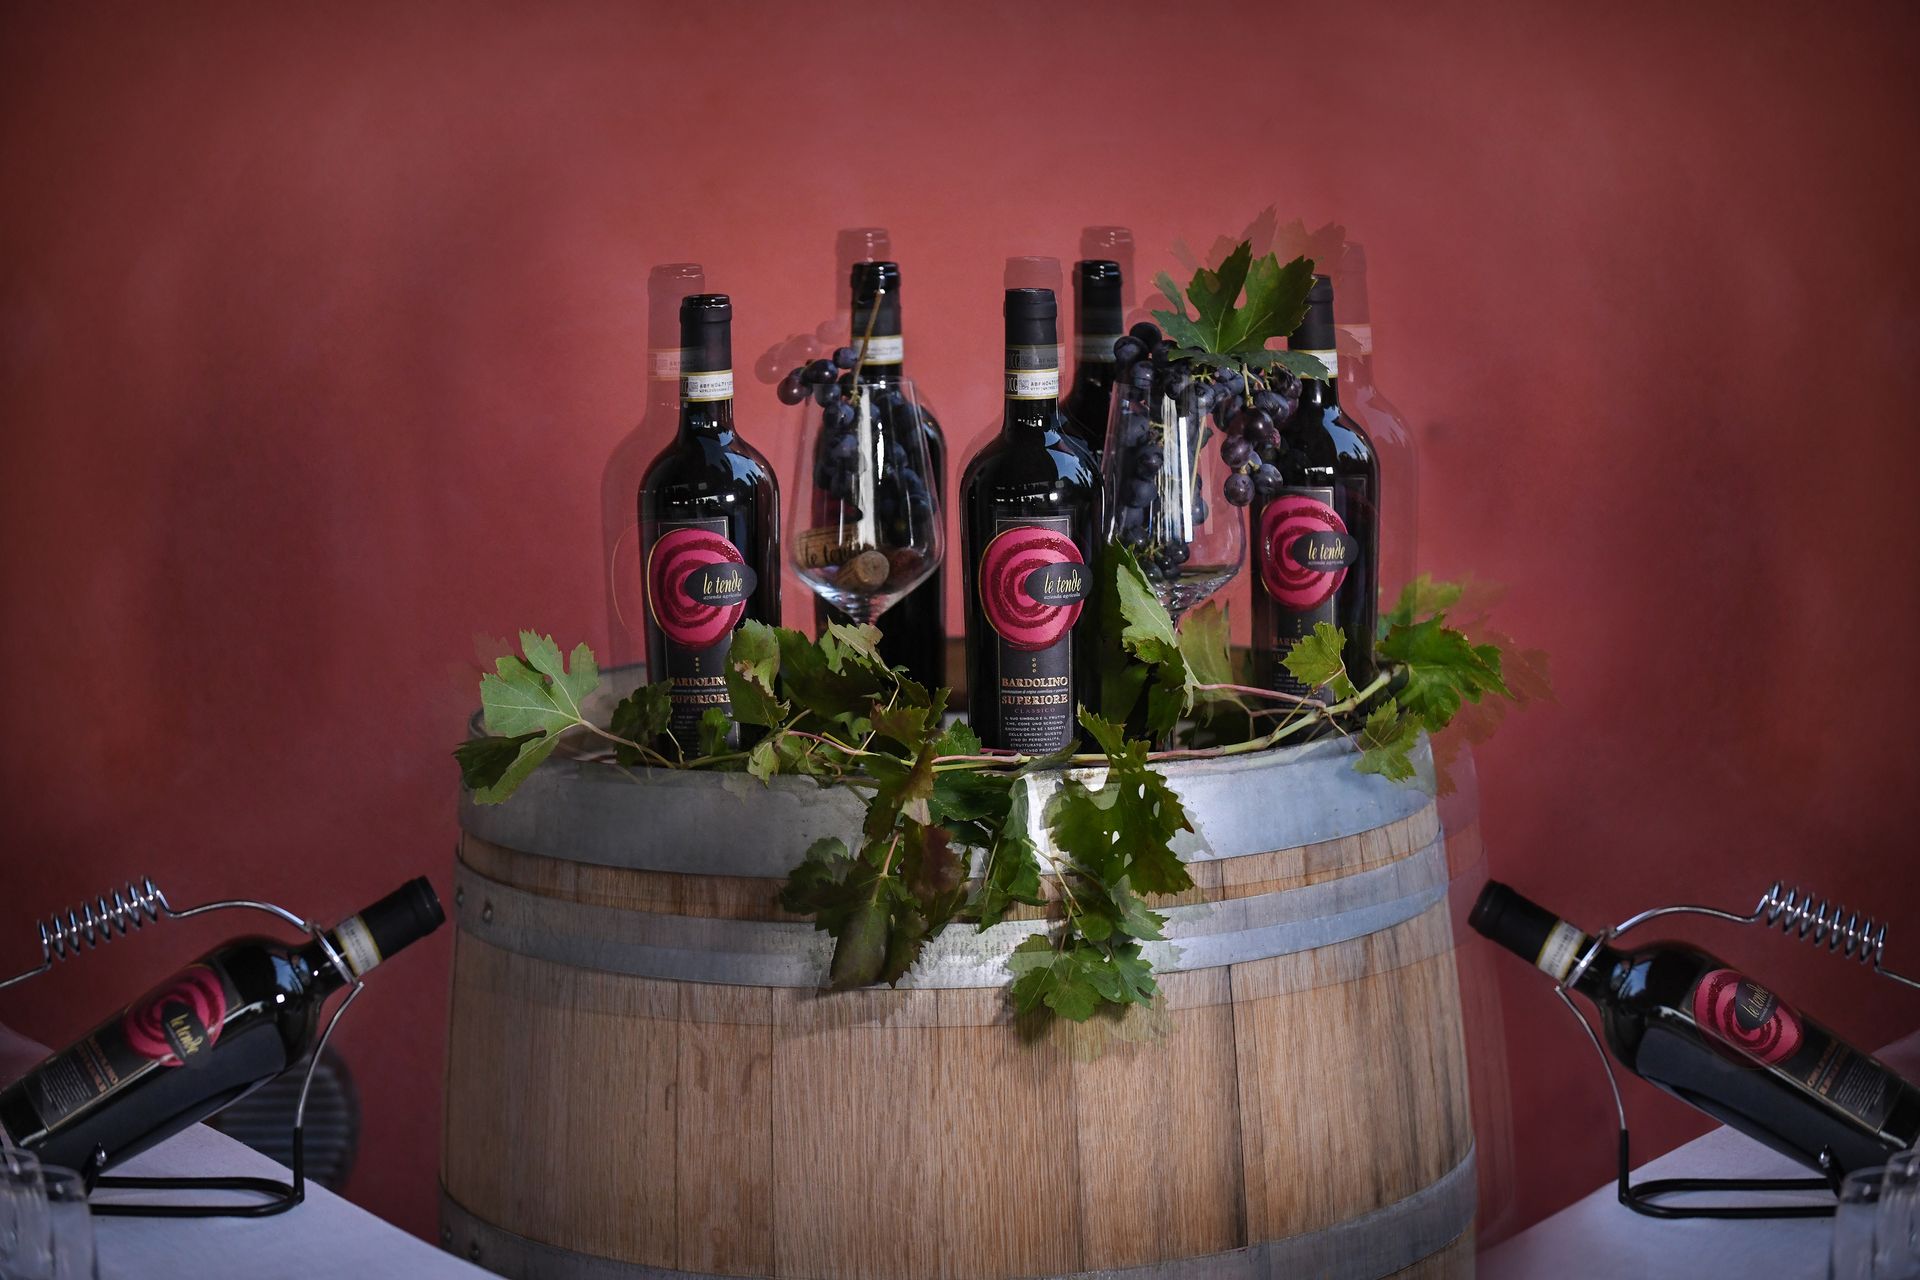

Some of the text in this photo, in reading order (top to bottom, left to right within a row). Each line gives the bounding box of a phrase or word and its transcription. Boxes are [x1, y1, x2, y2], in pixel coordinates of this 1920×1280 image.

[1308, 537, 1346, 560] le tende
[703, 569, 743, 595] le tende
[1044, 568, 1082, 594] le tende
[1001, 676, 1068, 687] BARDOLINO
[1001, 694, 1068, 705] SUPERIORE
